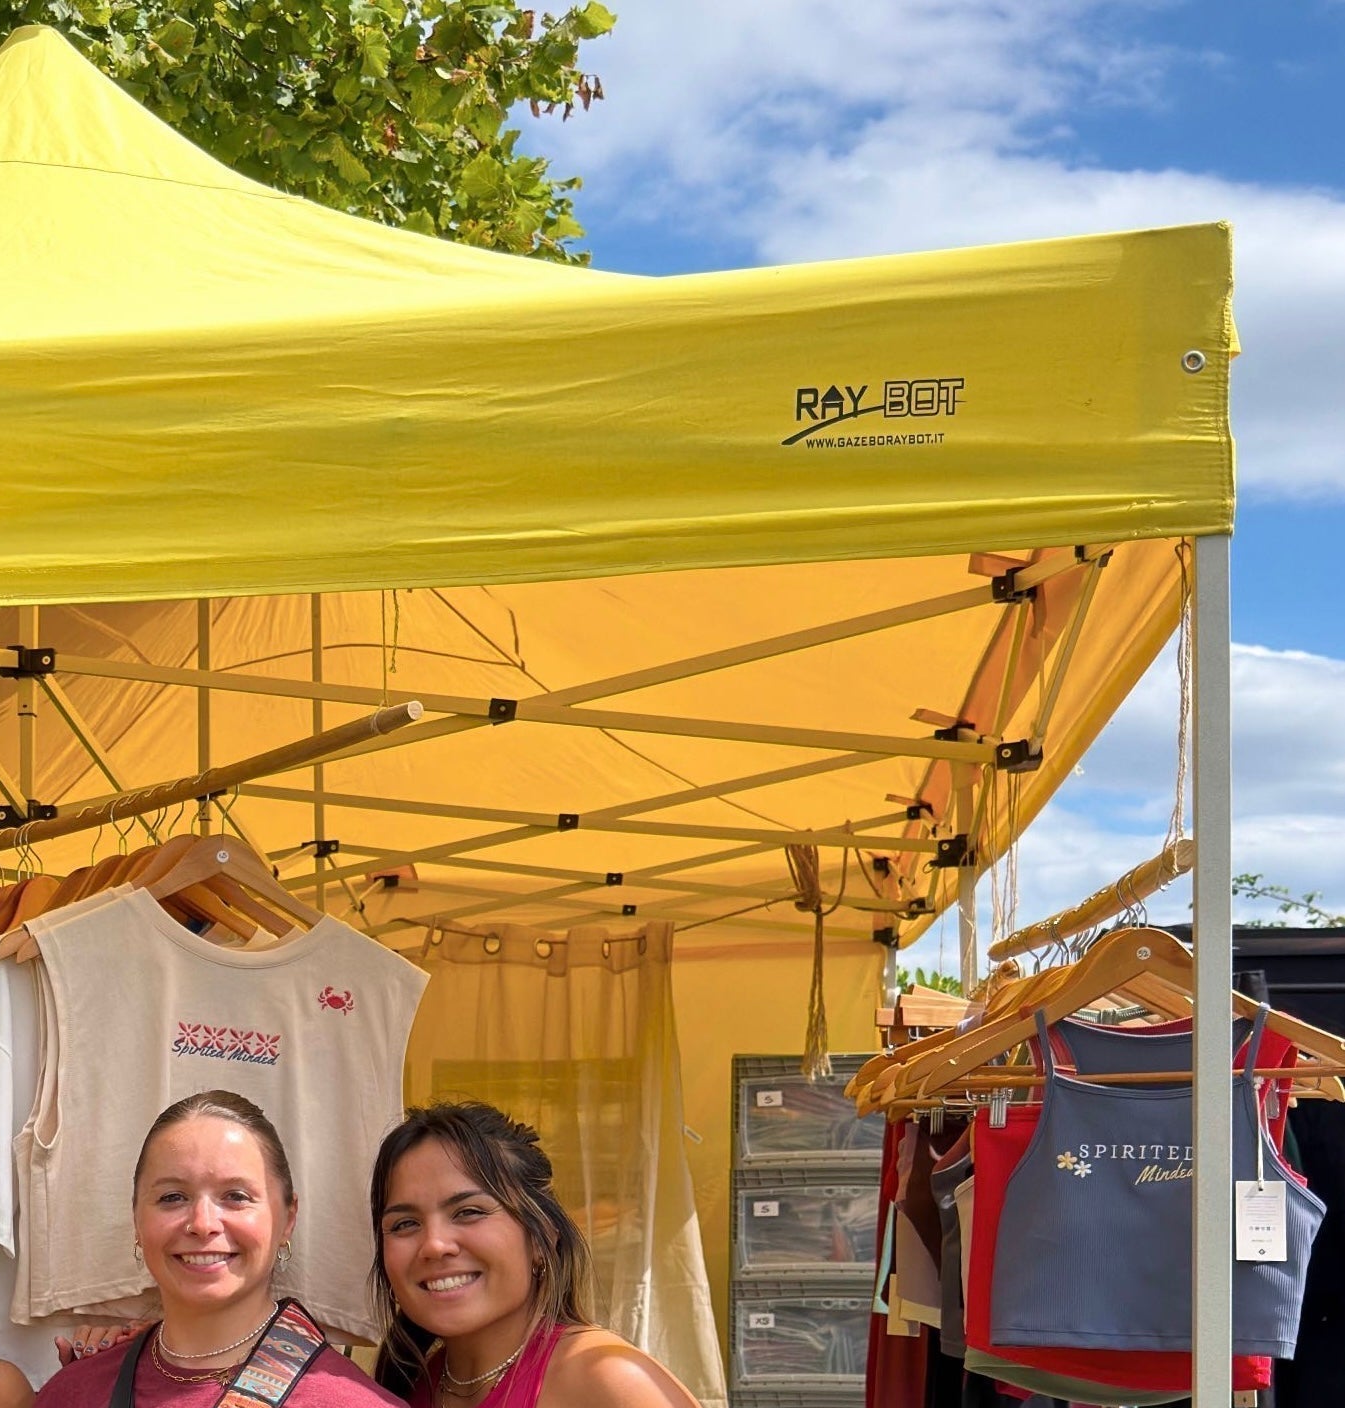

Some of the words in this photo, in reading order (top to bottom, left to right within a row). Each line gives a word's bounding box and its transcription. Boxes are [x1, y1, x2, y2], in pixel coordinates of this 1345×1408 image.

[796, 385, 868, 421] RAY
[884, 378, 964, 418] BOT
[806, 433, 945, 449] WWW.GAZEBORAYBOT.IT
[228, 1047, 280, 1066] Minded
